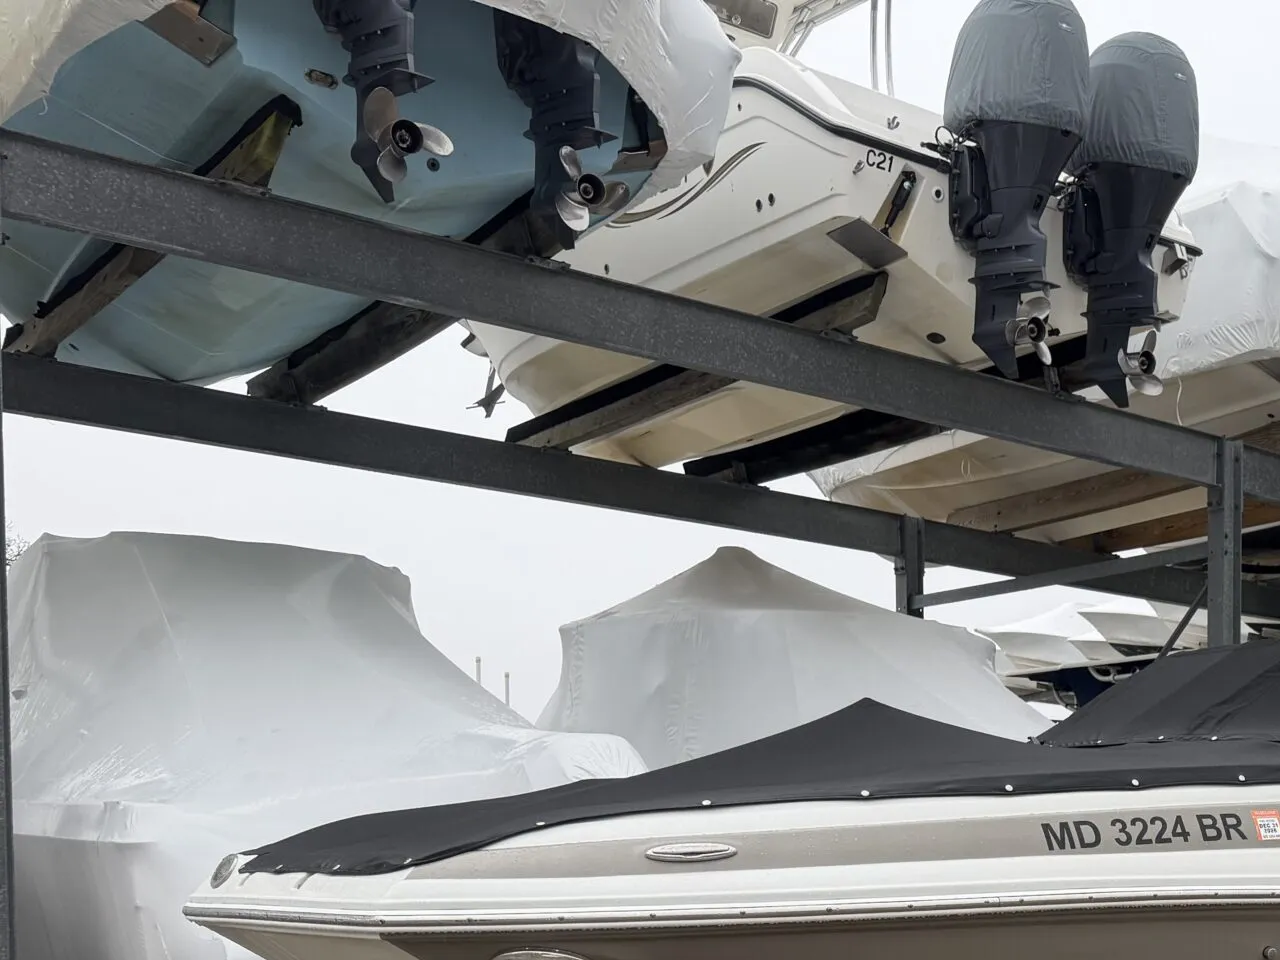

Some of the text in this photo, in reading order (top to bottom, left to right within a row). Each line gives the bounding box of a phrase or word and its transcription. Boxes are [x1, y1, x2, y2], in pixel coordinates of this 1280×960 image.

[866, 149, 894, 172] C21
[1041, 813, 1248, 851] MD 3224 BR
